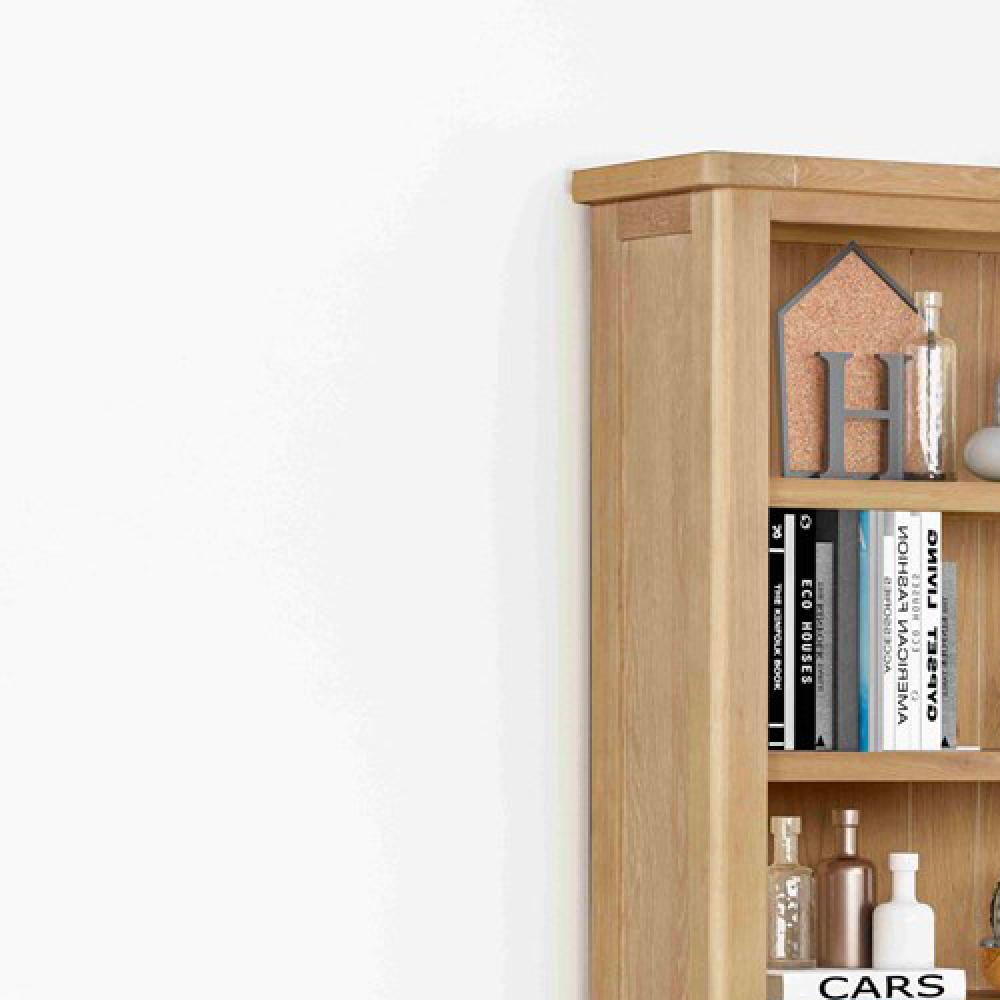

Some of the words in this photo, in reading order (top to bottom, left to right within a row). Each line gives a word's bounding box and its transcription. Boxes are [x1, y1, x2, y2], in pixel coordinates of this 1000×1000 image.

[801, 579, 813, 611] ECO
[801, 621, 813, 685] HOUSES
[819, 973, 945, 1000] CARS
